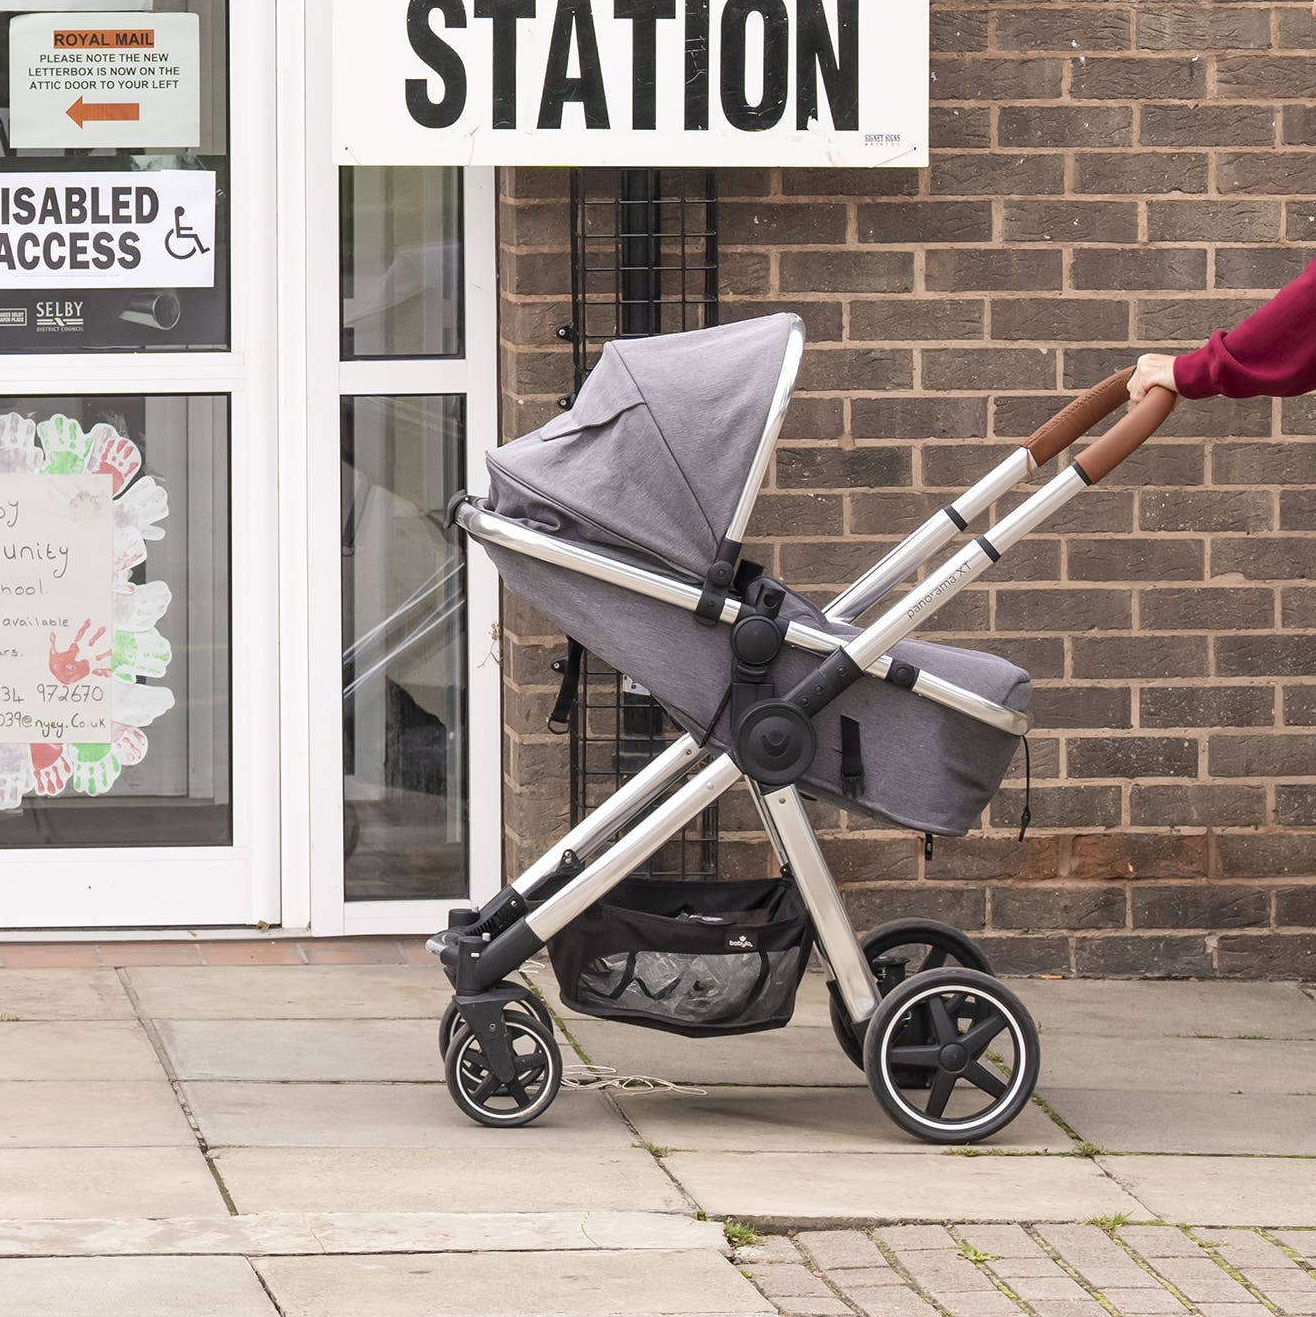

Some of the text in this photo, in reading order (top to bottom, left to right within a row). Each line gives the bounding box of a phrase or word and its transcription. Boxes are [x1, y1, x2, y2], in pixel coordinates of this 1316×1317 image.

[54, 33, 154, 46] ROYAL MAIL
[40, 53, 169, 63] PLEASE NOTE THE NEW
[28, 66, 179, 76] LETTERBOX IS NOW ON THE
[29, 80, 179, 90] ATTIC DOOR TO YOUR LEFT
[36, 301, 83, 317] SELBY
[907, 560, 971, 619] panorama XT
[2, 615, 71, 628] available
[37, 684, 104, 702] 972670
